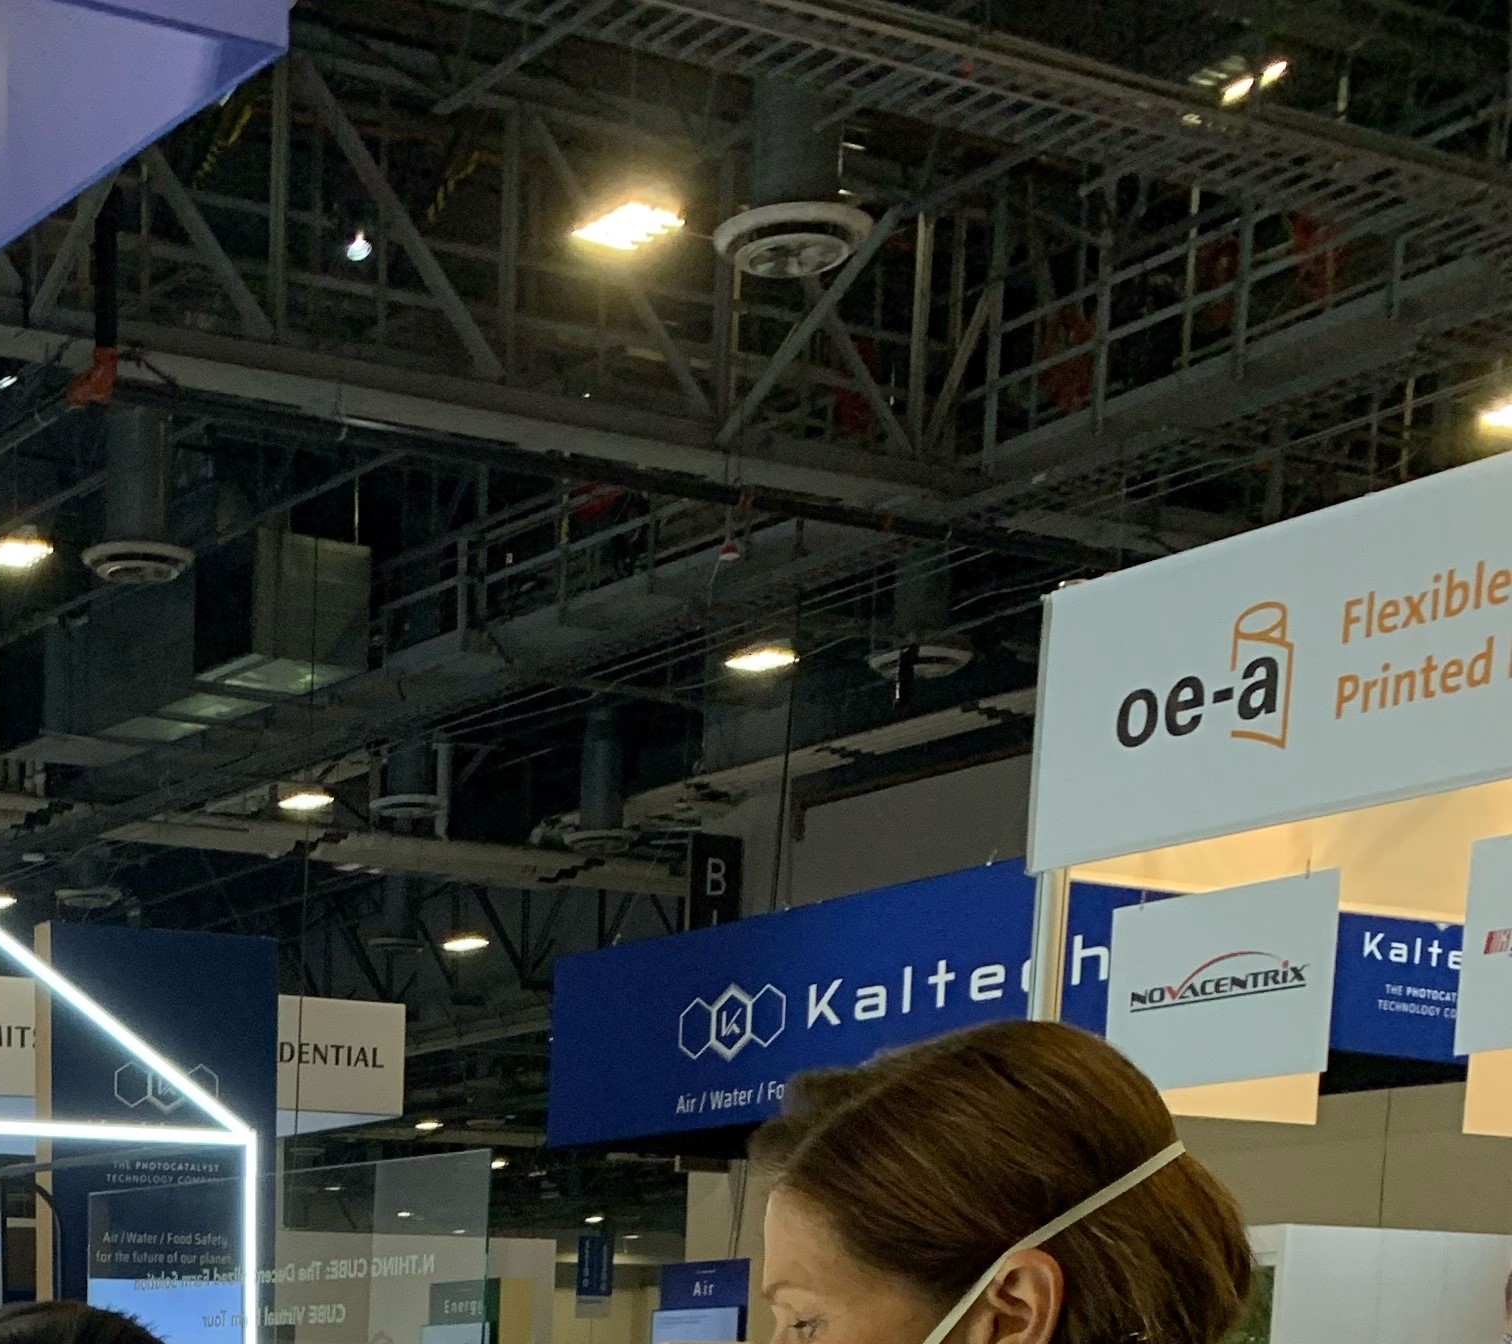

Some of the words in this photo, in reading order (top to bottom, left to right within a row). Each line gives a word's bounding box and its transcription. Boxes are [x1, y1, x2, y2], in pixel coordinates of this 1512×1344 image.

[1341, 560, 1512, 645] Flexible
[1333, 635, 1495, 720] Printed
[1116, 655, 1280, 749] oe-a
[706, 857, 726, 896] B
[1363, 931, 1463, 971] Kalte
[806, 935, 1110, 1029] Kalteh
[1385, 983, 1403, 997] THE
[1406, 985, 1457, 1003] PHOTOCAT
[279, 1041, 384, 1069] DENTIAL
[676, 1093, 697, 1114] Air
[710, 1087, 753, 1111] Water
[767, 1081, 785, 1101] Fo
[96, 1250, 112, 1264] for
[115, 1250, 131, 1264] the
[132, 1250, 165, 1265] future
[166, 1251, 178, 1265] of
[180, 1255, 196, 1266] our
[102, 1231, 119, 1245] Air
[126, 1232, 158, 1245] Water
[167, 1232, 193, 1246] Food
[194, 1232, 229, 1249] Safety
[693, 1280, 714, 1298] Air
